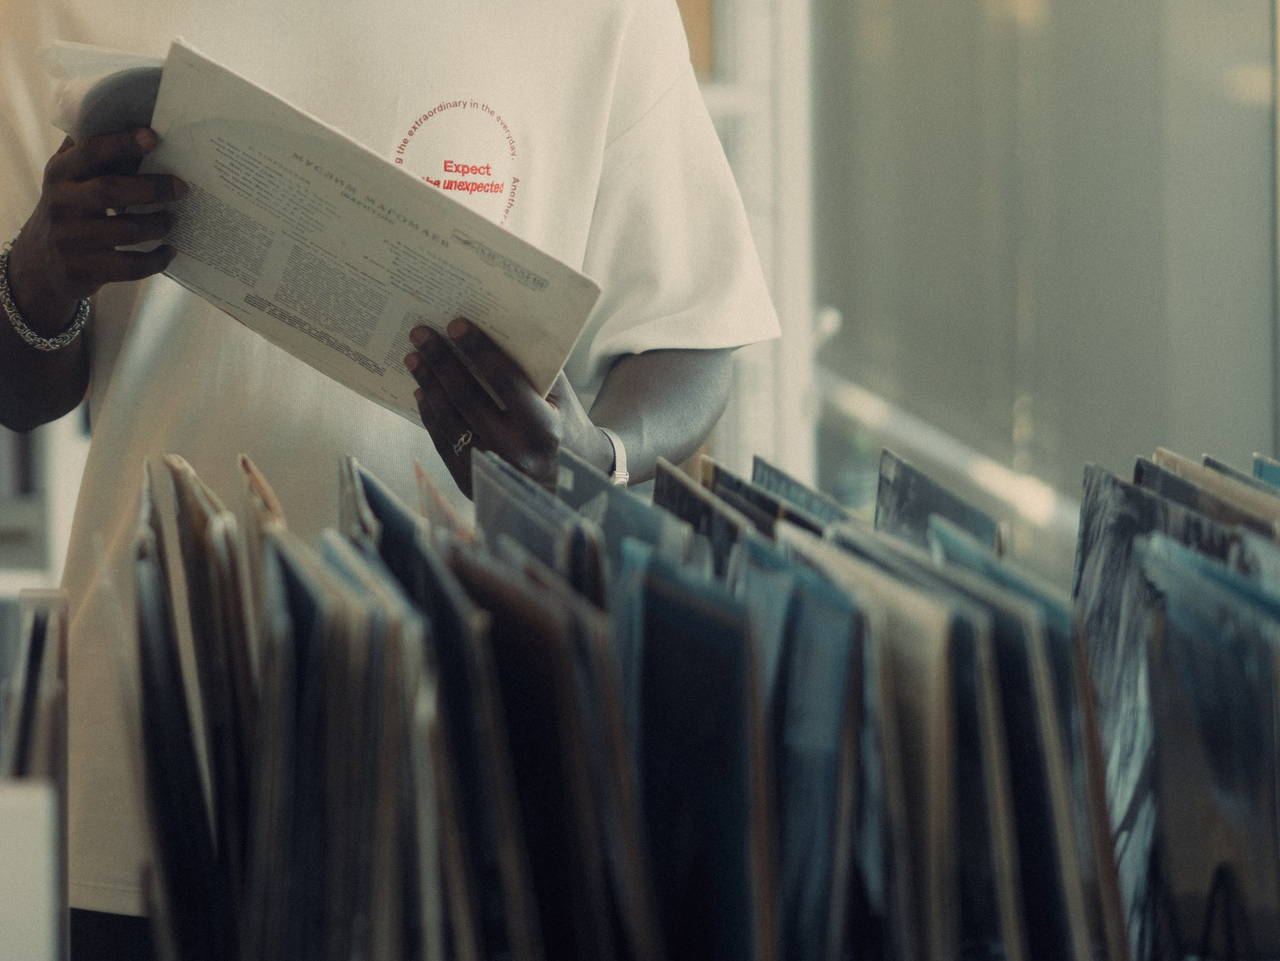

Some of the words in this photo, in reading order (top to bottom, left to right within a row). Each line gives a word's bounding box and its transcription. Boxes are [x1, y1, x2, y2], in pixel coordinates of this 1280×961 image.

[397, 138, 409, 154] the
[408, 100, 467, 137] extraordinary
[470, 99, 479, 109] in
[481, 103, 496, 117] the
[443, 160, 491, 176] Expect
[422, 176, 441, 188] he
[443, 180, 504, 195] unexpected
